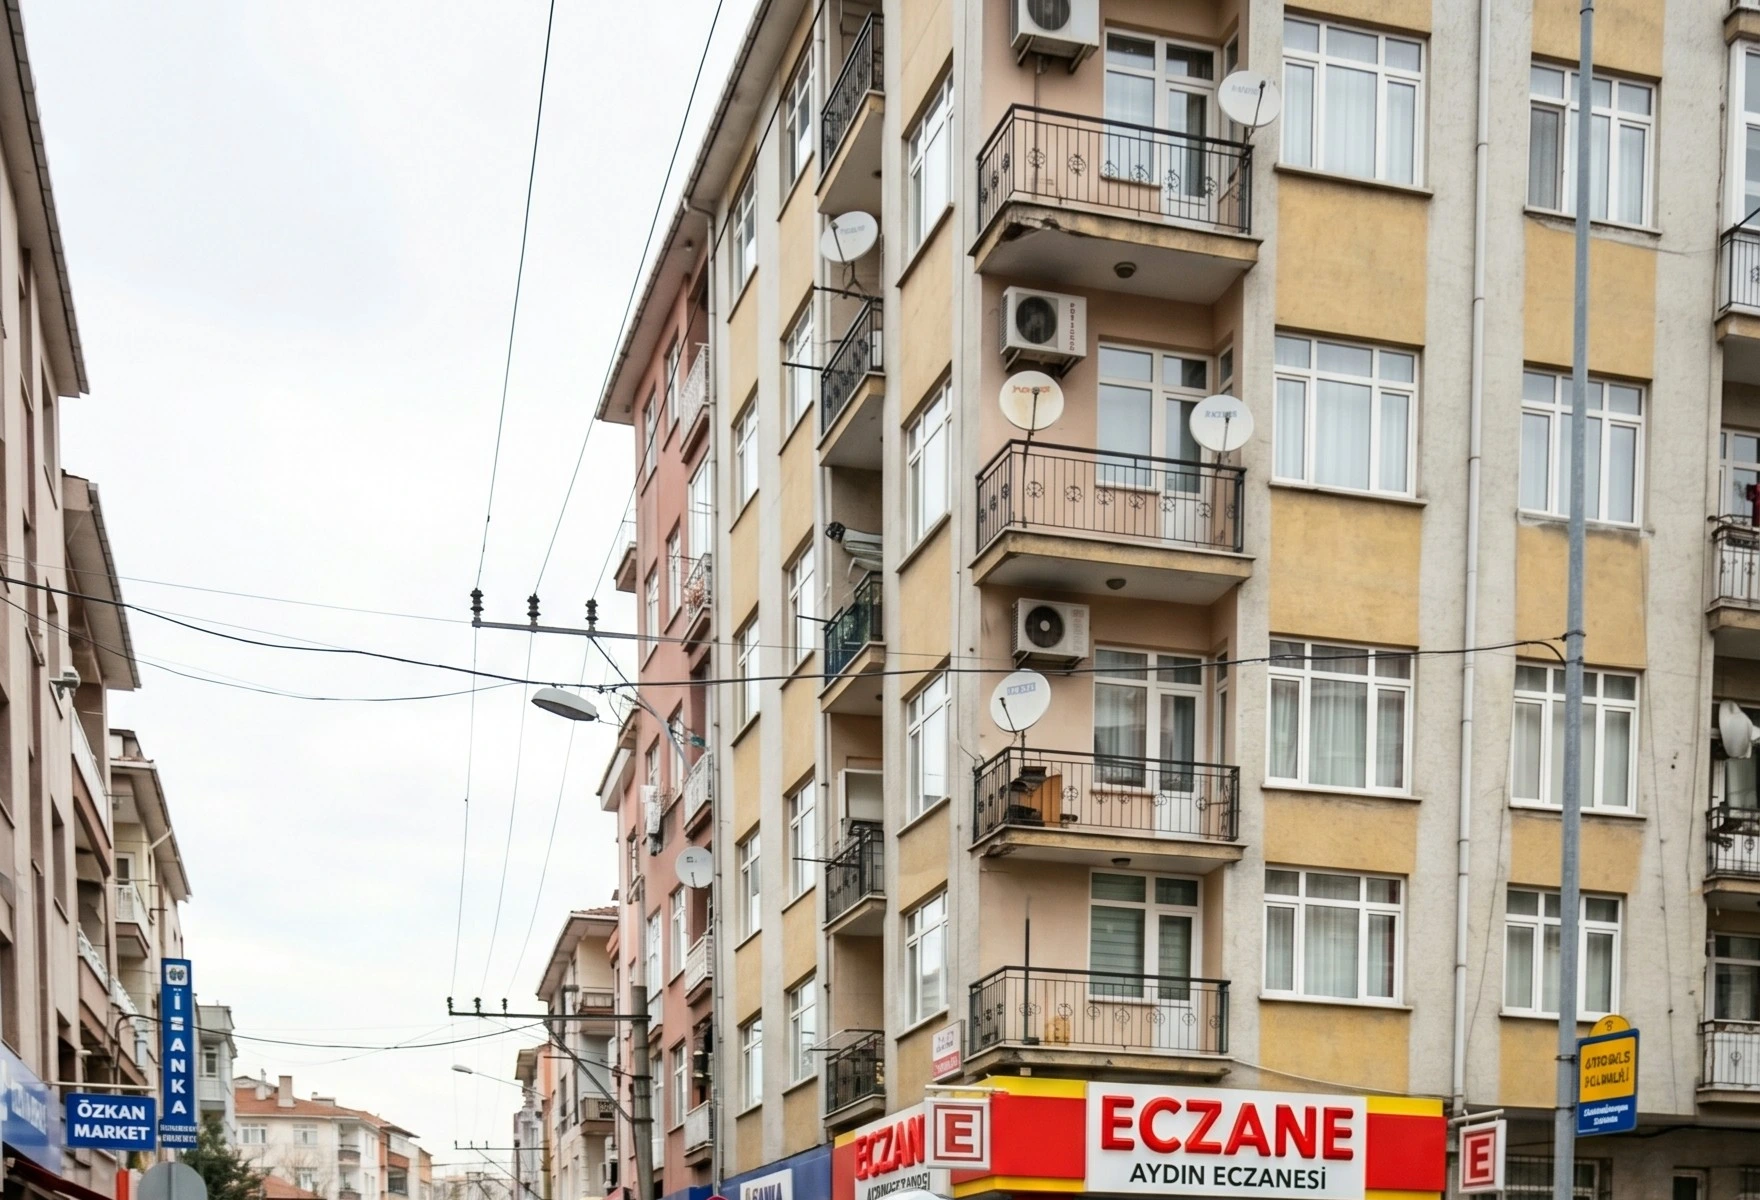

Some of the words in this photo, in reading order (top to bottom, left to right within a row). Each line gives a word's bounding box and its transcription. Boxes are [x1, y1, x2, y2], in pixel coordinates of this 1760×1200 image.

[77, 1100, 146, 1121] ÖZKAN
[74, 1123, 151, 1141] MARKET
[944, 1113, 974, 1154] E
[1101, 1095, 1354, 1161] ECZANE
[1469, 1137, 1491, 1180] E
[1129, 1163, 1205, 1186] AYDIN
[1213, 1166, 1327, 1190] ECZANESİ
